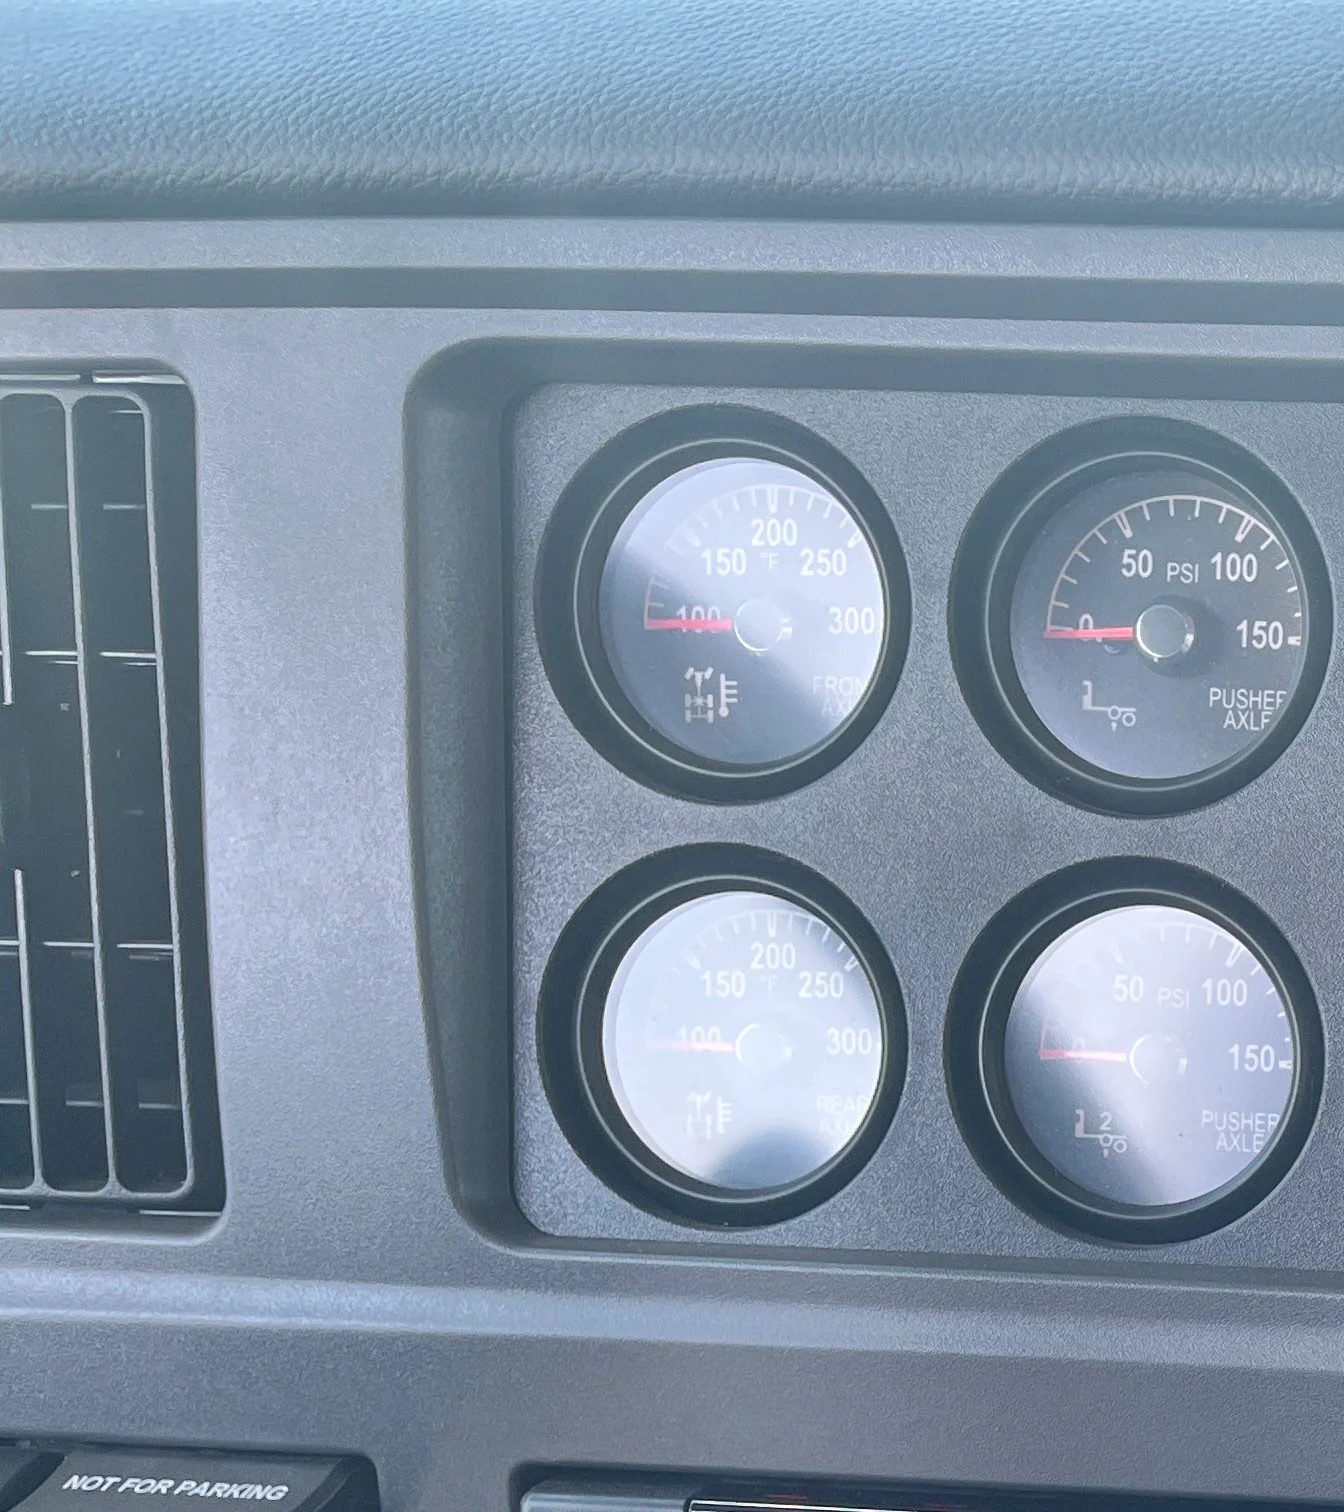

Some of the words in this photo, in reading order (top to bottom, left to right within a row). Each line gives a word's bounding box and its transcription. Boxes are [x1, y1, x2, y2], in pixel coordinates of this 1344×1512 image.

[751, 518, 797, 547] 200
[701, 548, 747, 576] 150
[800, 548, 847, 576] 250
[1121, 549, 1152, 578] 50
[1167, 562, 1199, 584] PSI
[1210, 552, 1258, 583] 100
[676, 605, 721, 633] 100
[828, 606, 875, 635] 300
[1236, 620, 1284, 650] 150
[812, 676, 866, 697] FRON
[750, 942, 796, 970] 200
[700, 970, 746, 998] 150
[798, 971, 844, 999] 250
[1113, 974, 1144, 1002] 50
[1202, 977, 1248, 1007] 100
[1157, 988, 1190, 1009] PSI
[826, 1027, 873, 1056] 300
[1229, 1044, 1276, 1073] 150
[1216, 1132, 1265, 1154] AXLE
[63, 1474, 120, 1492] NOT
[118, 1477, 176, 1495] FOR
[173, 1478, 289, 1501] PARKING
